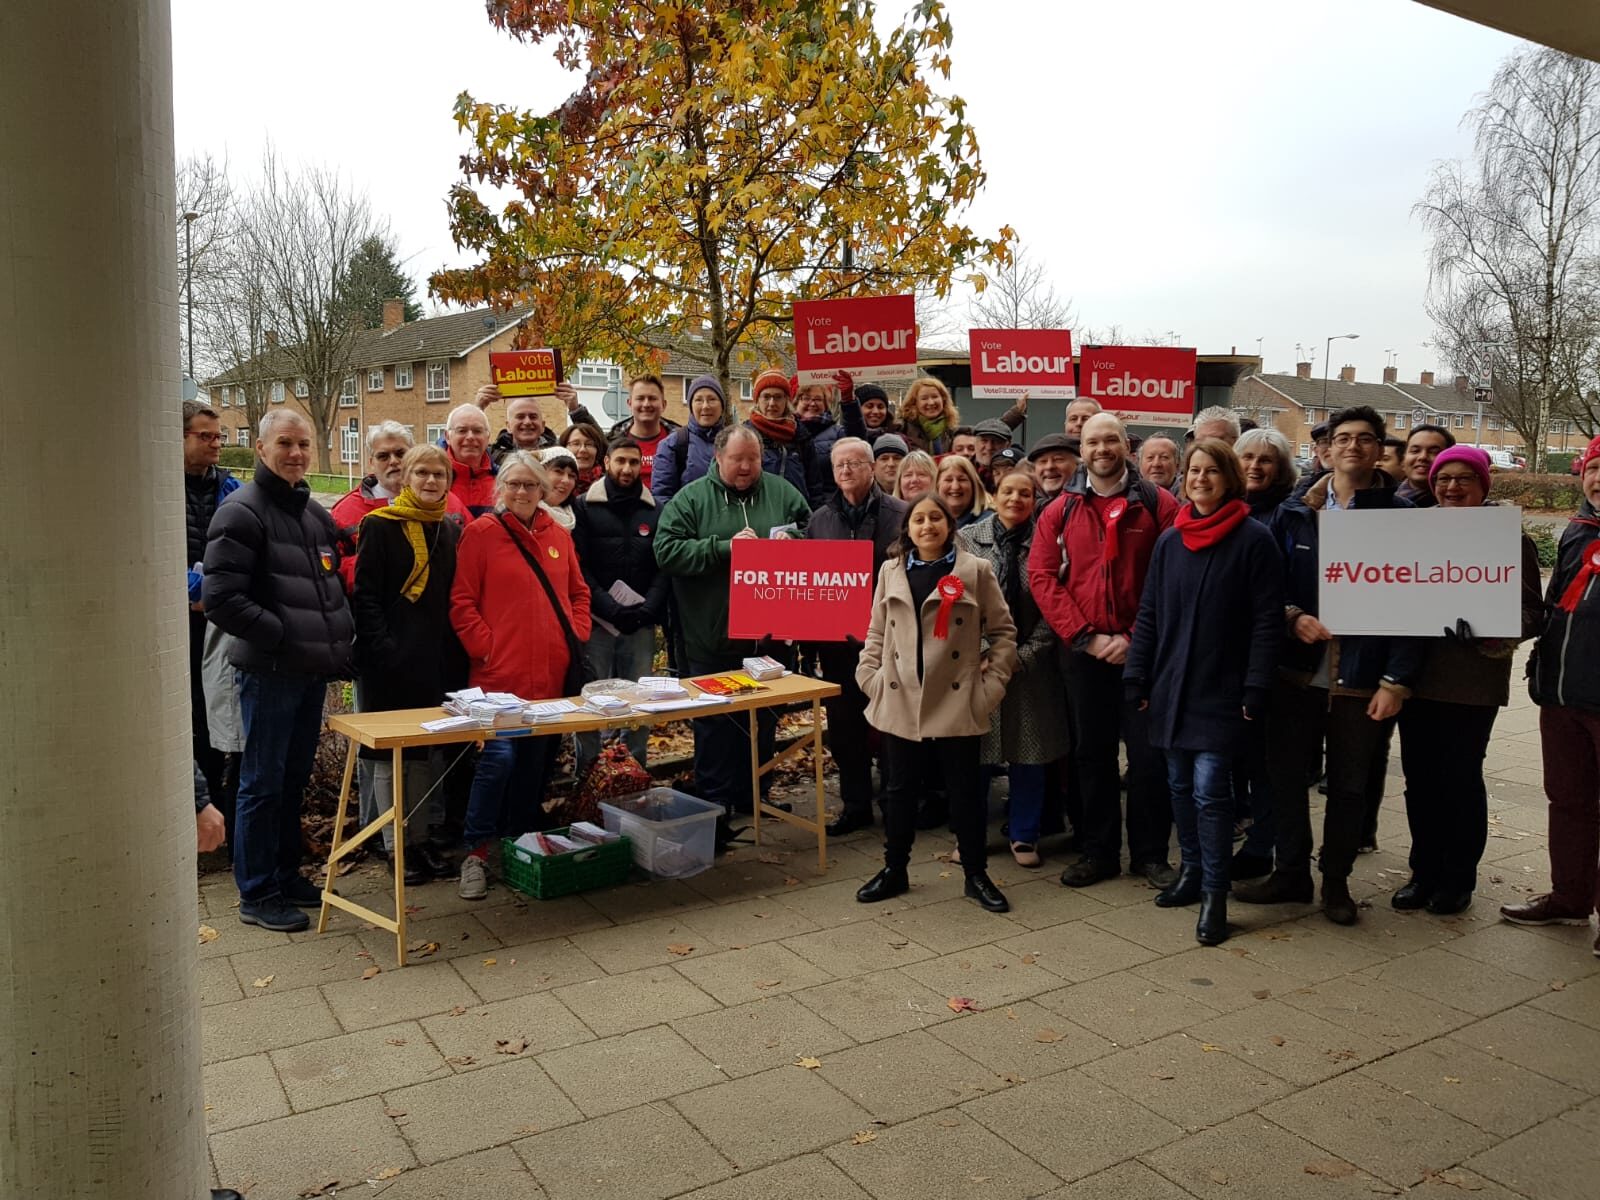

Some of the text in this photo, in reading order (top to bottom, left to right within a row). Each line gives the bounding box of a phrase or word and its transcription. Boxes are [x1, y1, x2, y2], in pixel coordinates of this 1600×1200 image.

[807, 316, 831, 327] Vote
[808, 326, 913, 354] Labour
[980, 342, 1002, 350] Vote
[520, 354, 552, 366] vote
[981, 351, 1070, 373] Labour
[1092, 360, 1115, 370] Vote
[496, 368, 554, 382] Labour
[1091, 371, 1191, 399] Labour
[733, 570, 870, 588] FOR THE MANY
[1324, 560, 1515, 584] #VoteLabour
[754, 587, 849, 601] NOT THE FEW
